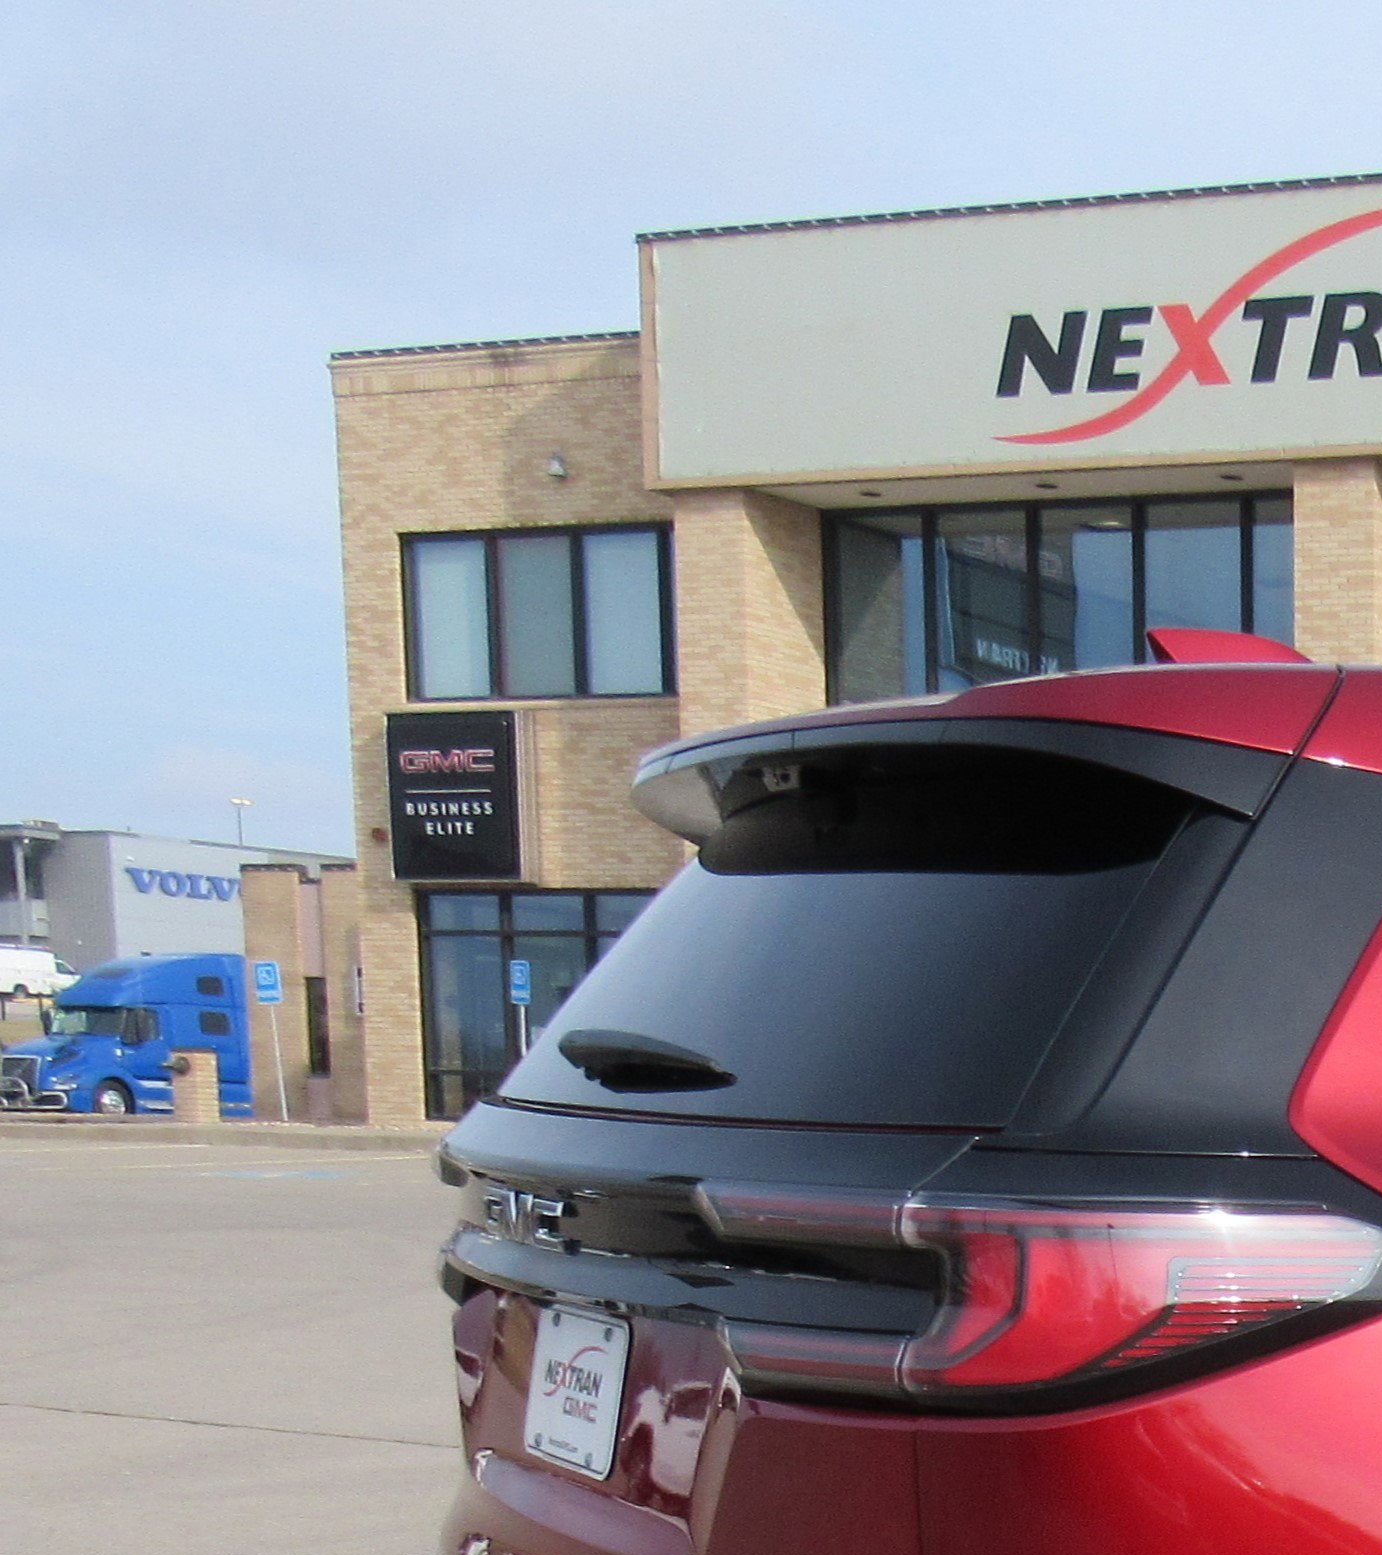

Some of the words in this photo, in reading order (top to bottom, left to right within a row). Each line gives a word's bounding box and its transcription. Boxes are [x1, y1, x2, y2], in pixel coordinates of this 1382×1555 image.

[401, 749, 495, 773] GMC
[405, 802, 494, 816] BUSINESS
[425, 821, 475, 836] ELITE
[125, 867, 242, 902] VOLV
[545, 1359, 603, 1398] NEXTRAN
[563, 1396, 598, 1424] GMC
